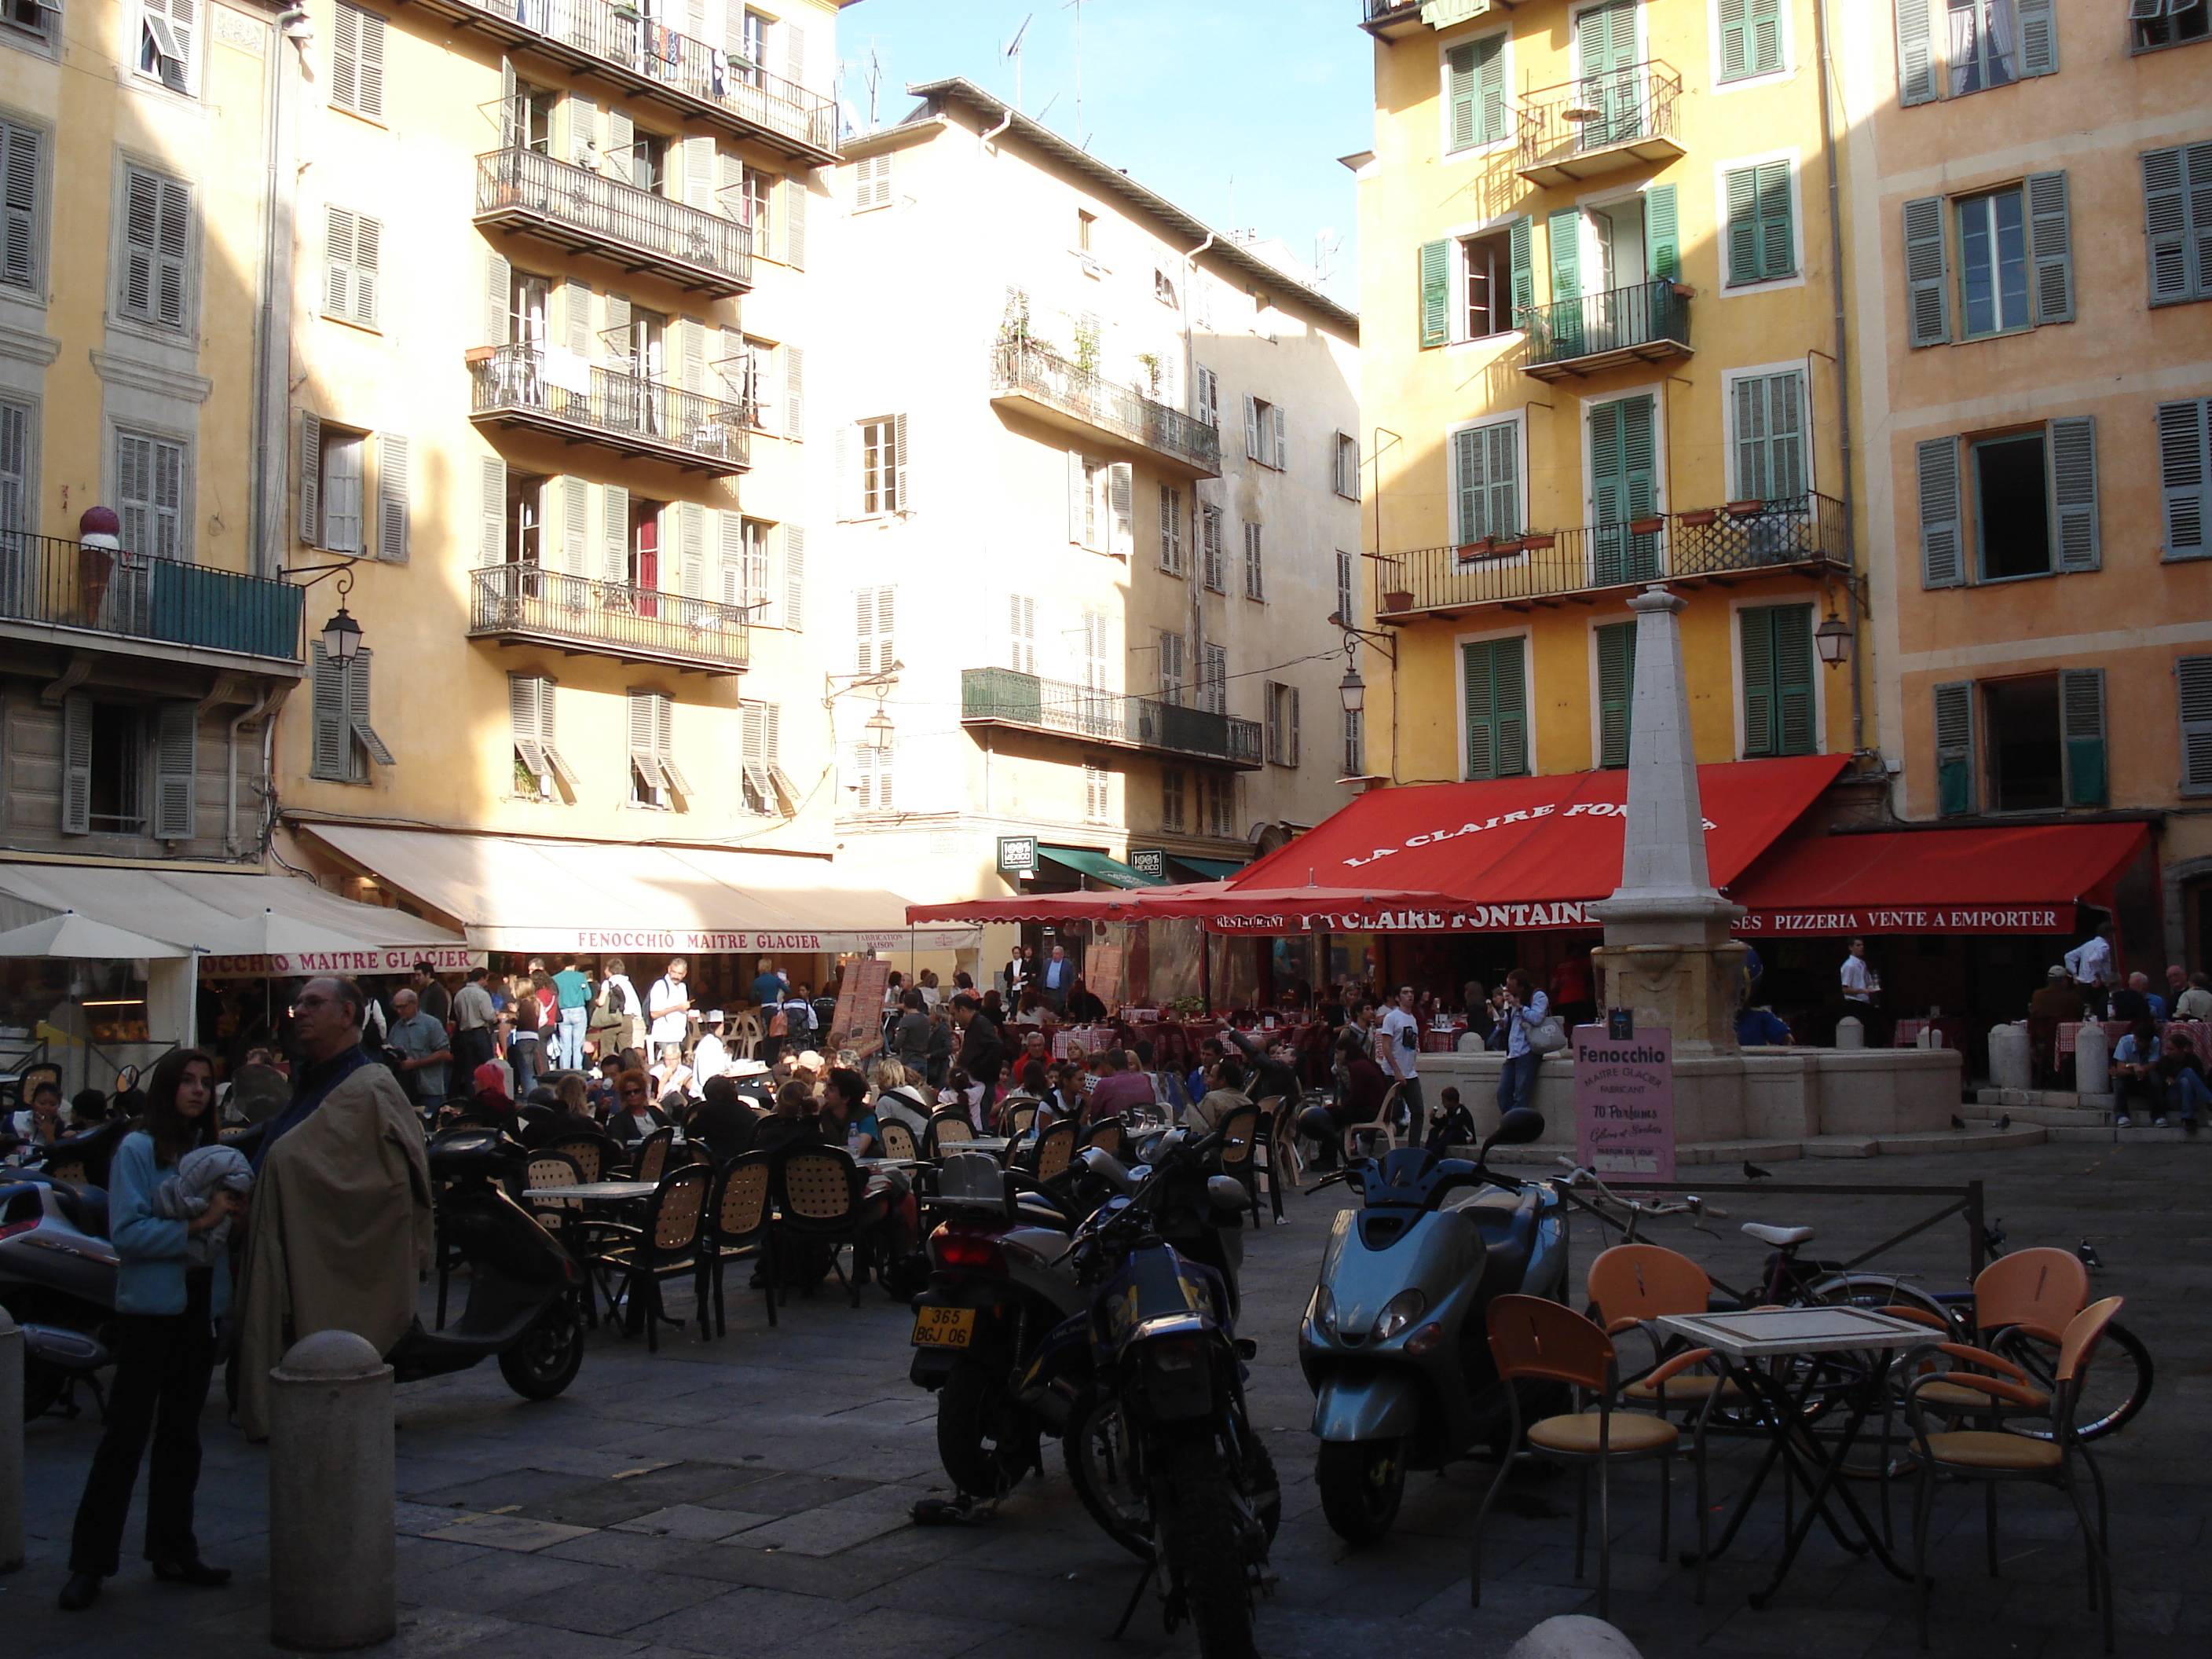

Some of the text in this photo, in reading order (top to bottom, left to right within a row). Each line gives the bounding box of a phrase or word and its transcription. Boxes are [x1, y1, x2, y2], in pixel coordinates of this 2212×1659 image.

[1343, 848, 1398, 867] LA
[1405, 804, 1555, 848] CLAIRE
[1004, 841, 1031, 854] 100%
[1134, 854, 1159, 865] 100%
[1217, 914, 1284, 928] RESTAURANT
[1342, 911, 1445, 929] CLAIRE
[1774, 914, 1858, 930] PIZZERIA
[1867, 911, 1928, 927] VENTE
[1932, 912, 1946, 927] A
[1950, 911, 2056, 927] EMPORTER
[578, 932, 821, 950] FENOCCHIO MAITRE GLACIER
[299, 952, 379, 970] MAITRE
[386, 950, 472, 969] GLACIER
[1579, 1046, 1665, 1064] Fenocchio
[1584, 1068, 1662, 1088] MAITRE GLACIER
[1593, 1105, 1606, 1118] 70
[932, 1309, 961, 1324] 365
[915, 1326, 967, 1344] BGJ 06
